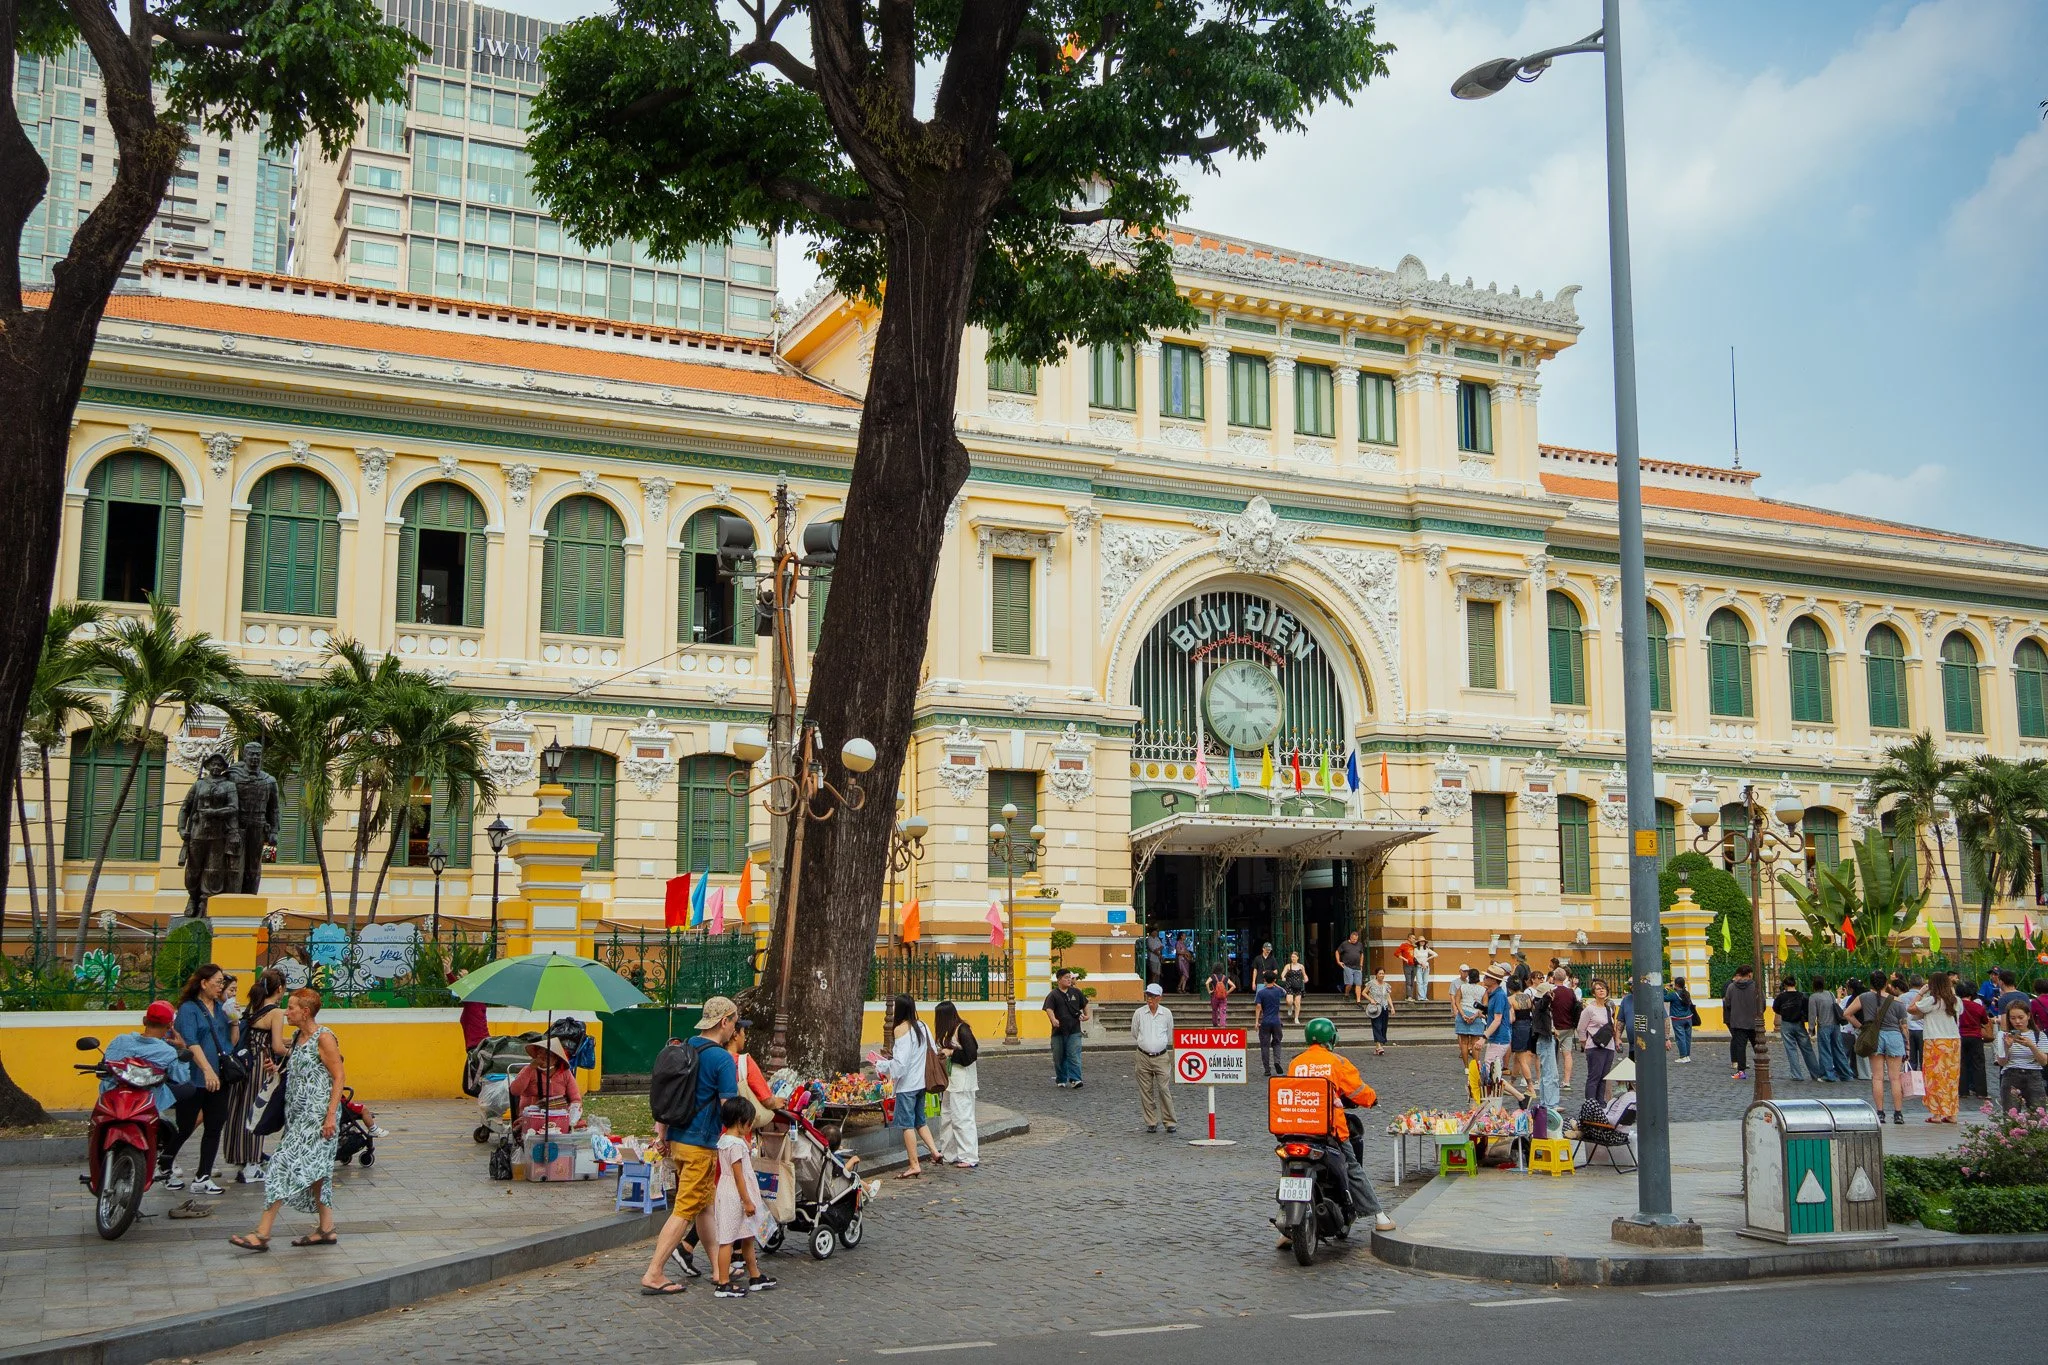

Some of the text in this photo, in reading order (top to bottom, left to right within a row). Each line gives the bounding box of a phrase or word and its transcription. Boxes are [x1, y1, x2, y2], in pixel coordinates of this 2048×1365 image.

[472, 38, 509, 57] JW
[1244, 605, 1315, 661] ĐIỆN
[1649, 840, 1653, 848] 3
[1181, 1032, 1238, 1046] KHU VỰC
[1209, 1054, 1243, 1069] CẤM ĐẬU XE
[1309, 1068, 1331, 1077] Food
[1295, 1089, 1319, 1097] Shopee
[1295, 1097, 1319, 1105] Food
